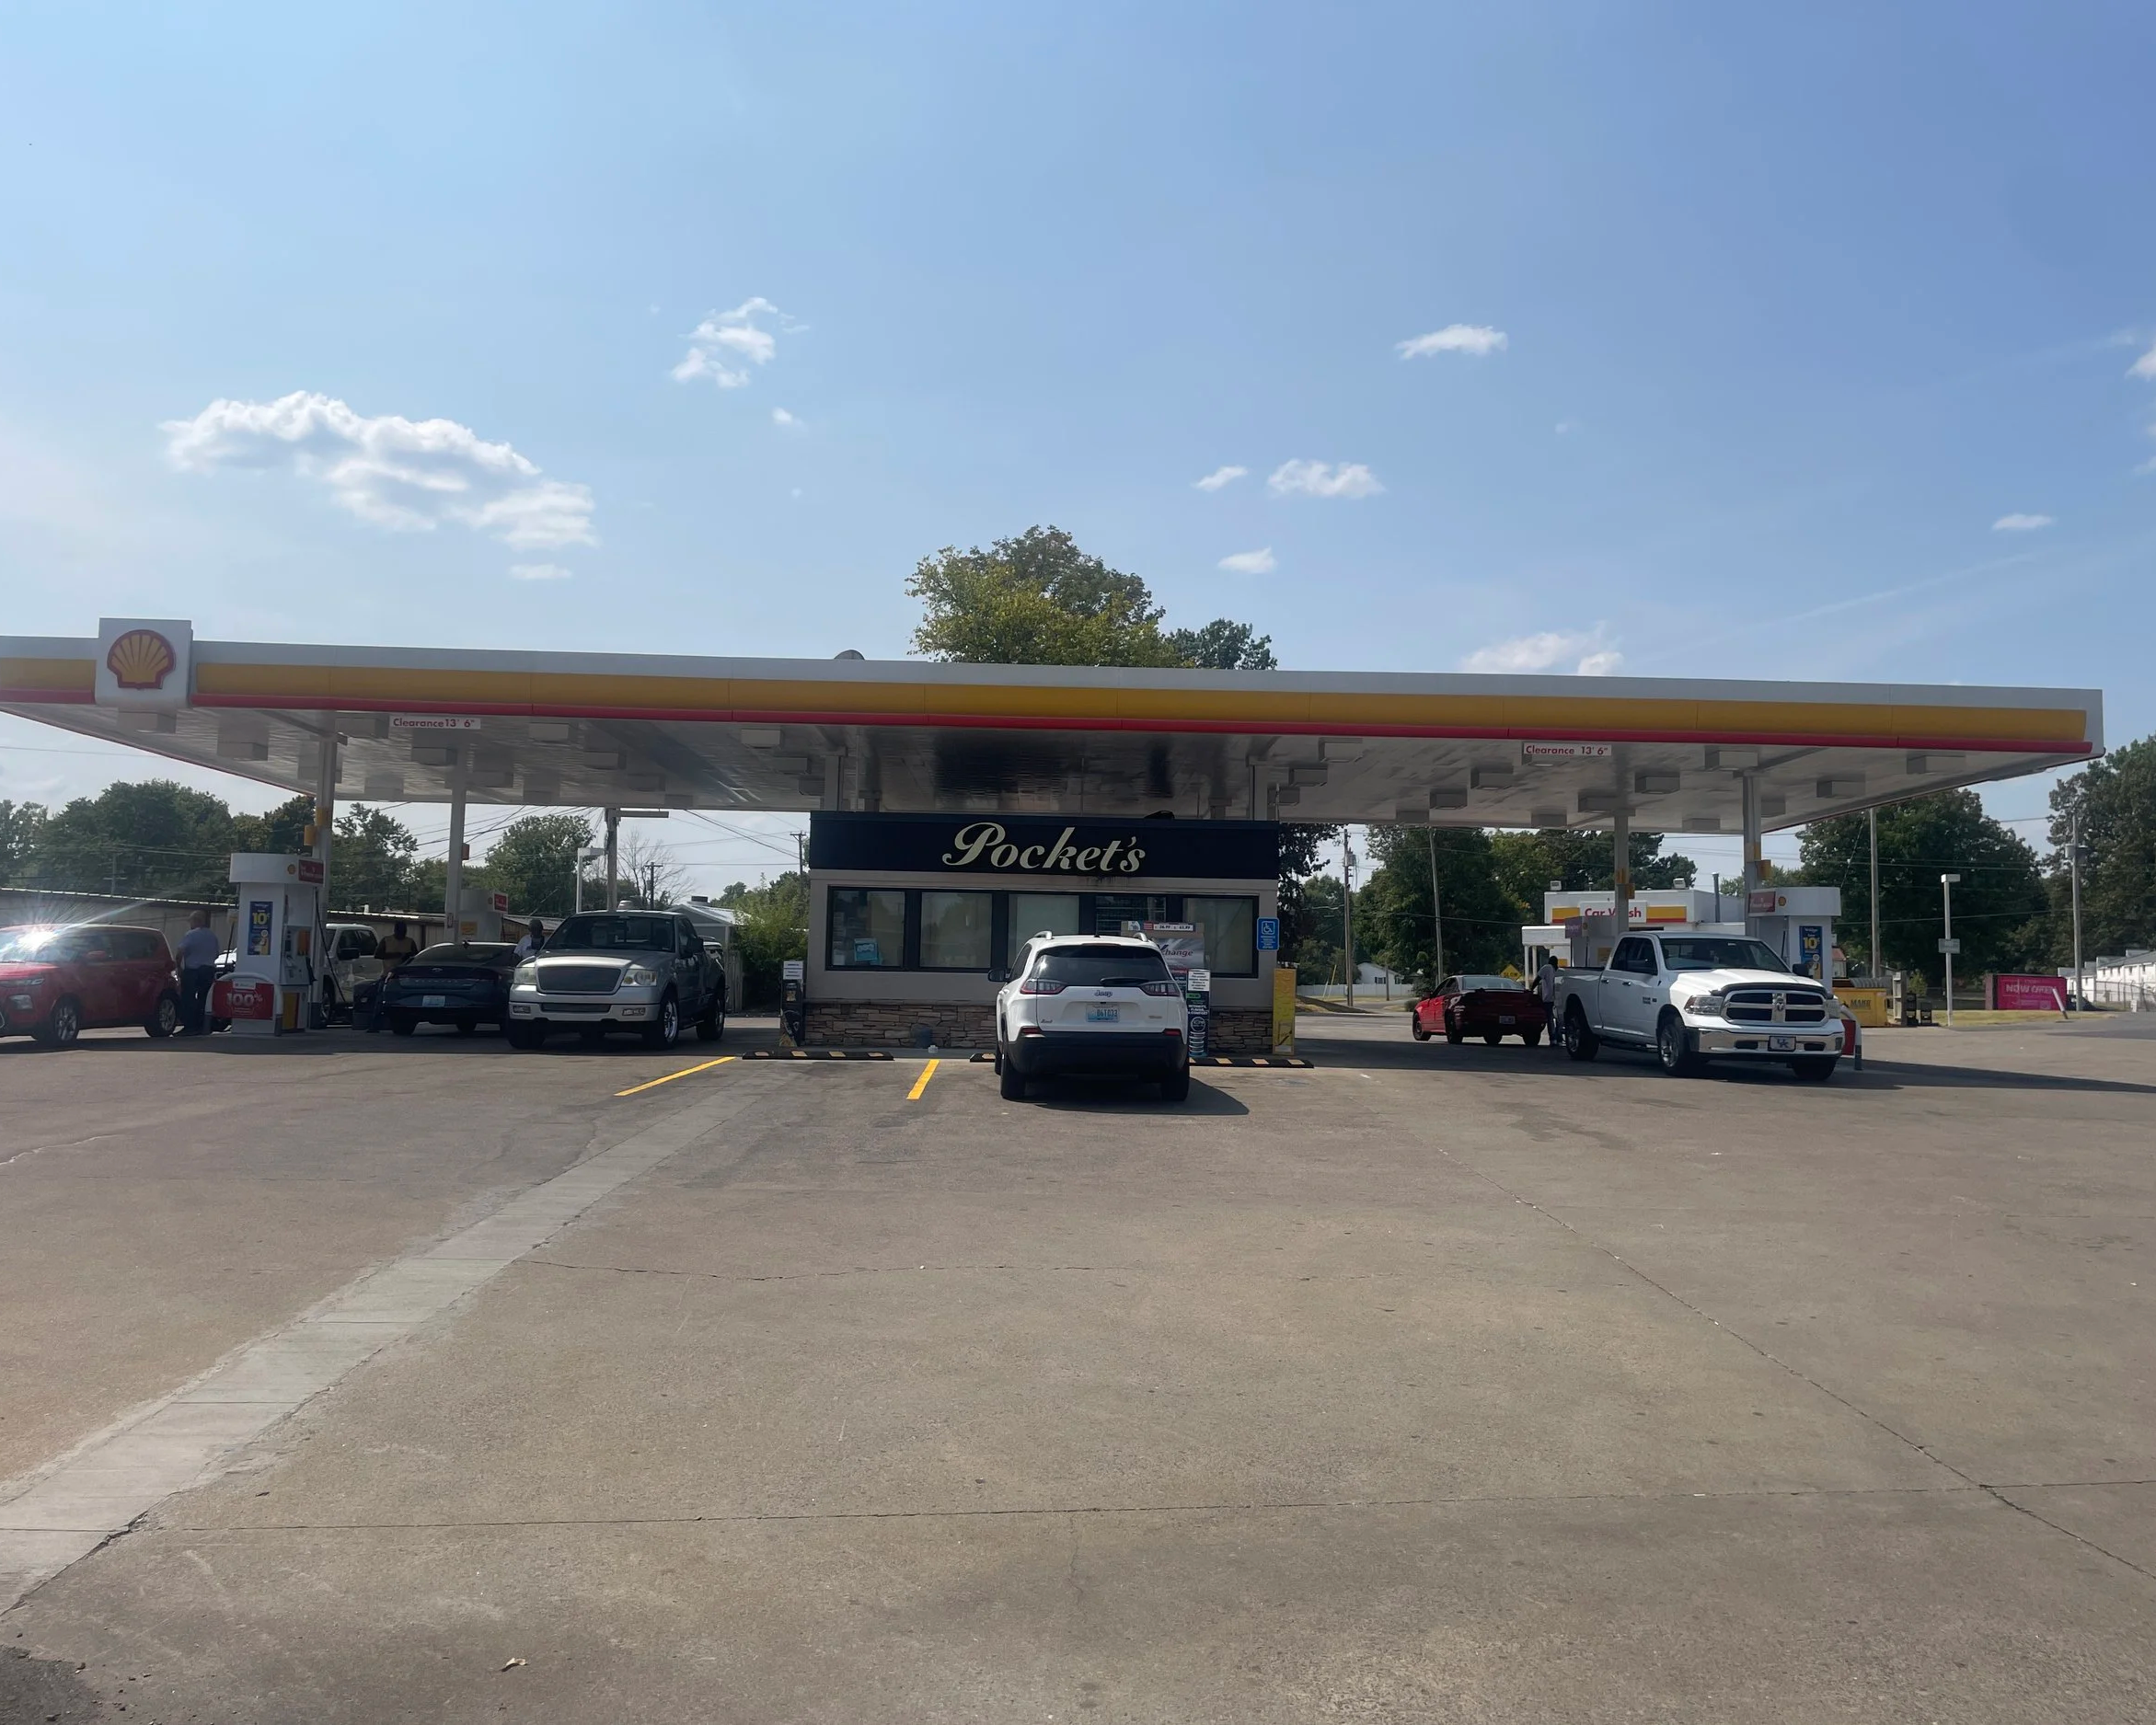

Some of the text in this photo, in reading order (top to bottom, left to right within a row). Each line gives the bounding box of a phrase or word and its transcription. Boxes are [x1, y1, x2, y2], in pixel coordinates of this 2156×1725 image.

[392, 718, 475, 728] Clearance 13' 6"
[1526, 744, 1608, 755] Clearance 13' 6"
[941, 821, 1146, 872] Pocket's
[1585, 908, 1606, 917] Car
[1094, 989, 1113, 998] Jeep
